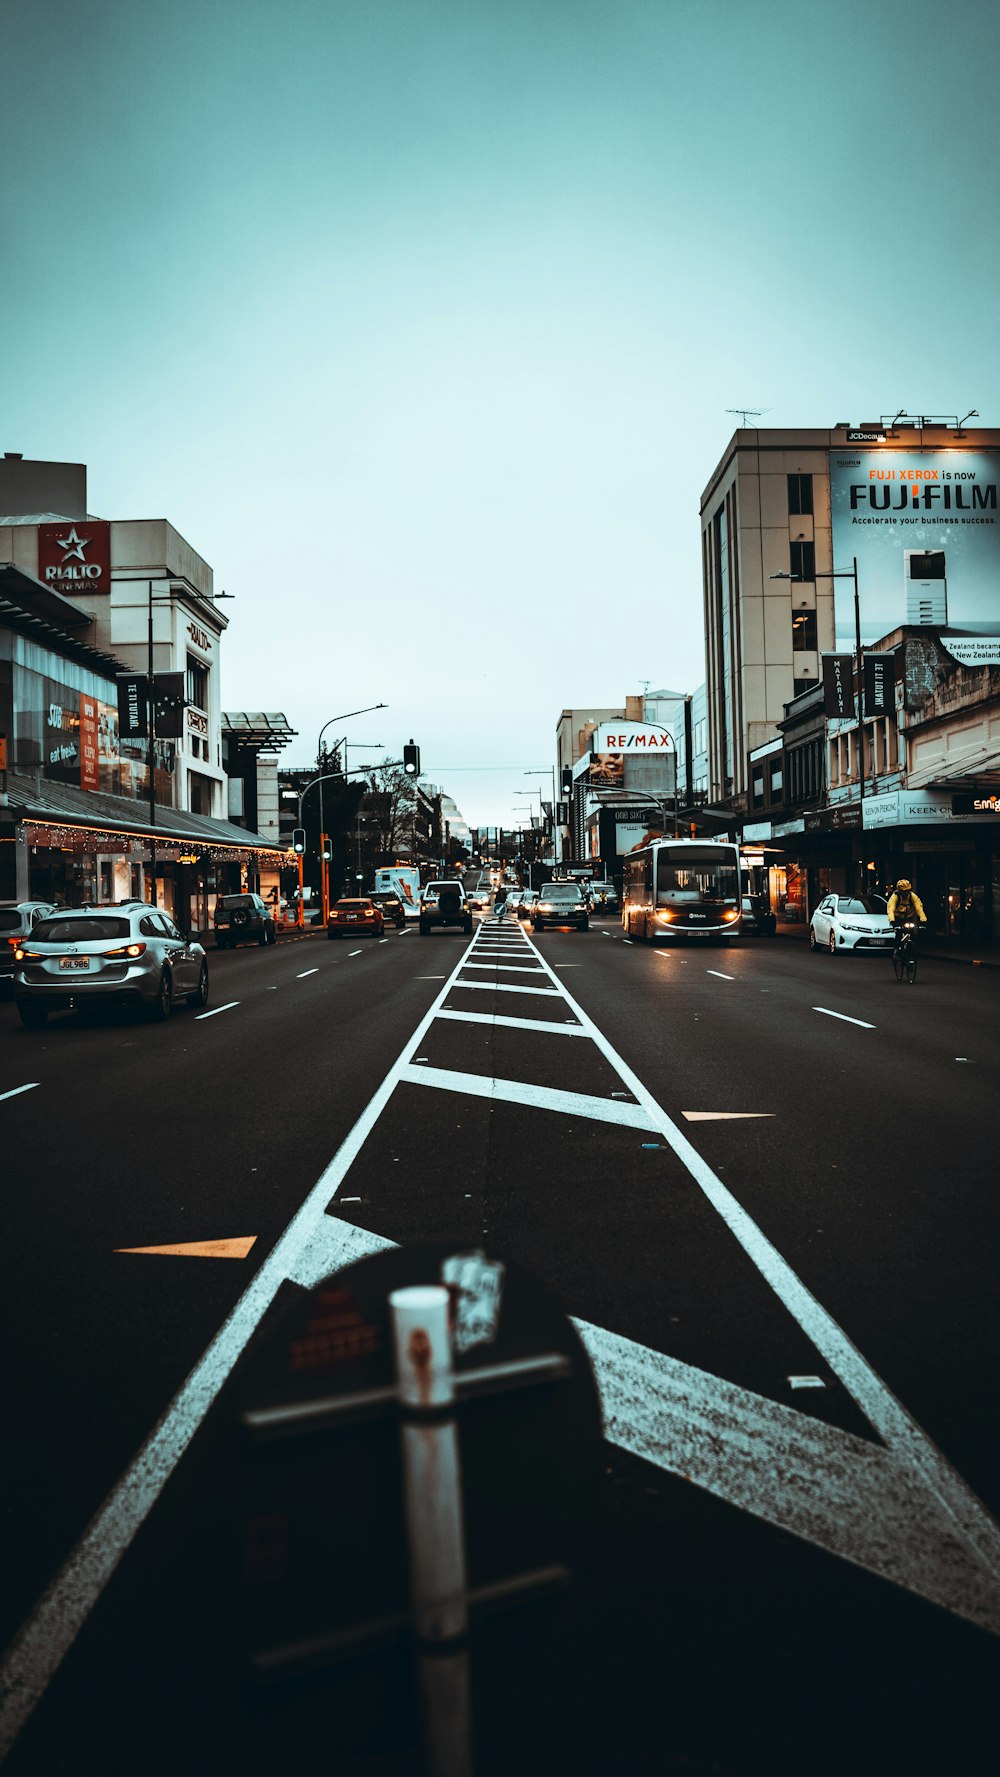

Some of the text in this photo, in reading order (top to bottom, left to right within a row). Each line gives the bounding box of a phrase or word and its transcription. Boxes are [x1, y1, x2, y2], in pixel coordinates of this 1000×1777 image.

[869, 470, 976, 480] FUJI XEROX is now
[850, 484, 997, 510] FUJIFILM
[852, 516, 997, 526] Accelerate your business success.
[45, 563, 102, 580] RIALTO
[51, 581, 98, 591] CINEMAS
[973, 651, 1000, 659] Zealand
[128, 684, 137, 692] TE
[606, 735, 669, 747] RE/MAX
[50, 746, 60, 763] eat
[615, 811, 628, 820] one
